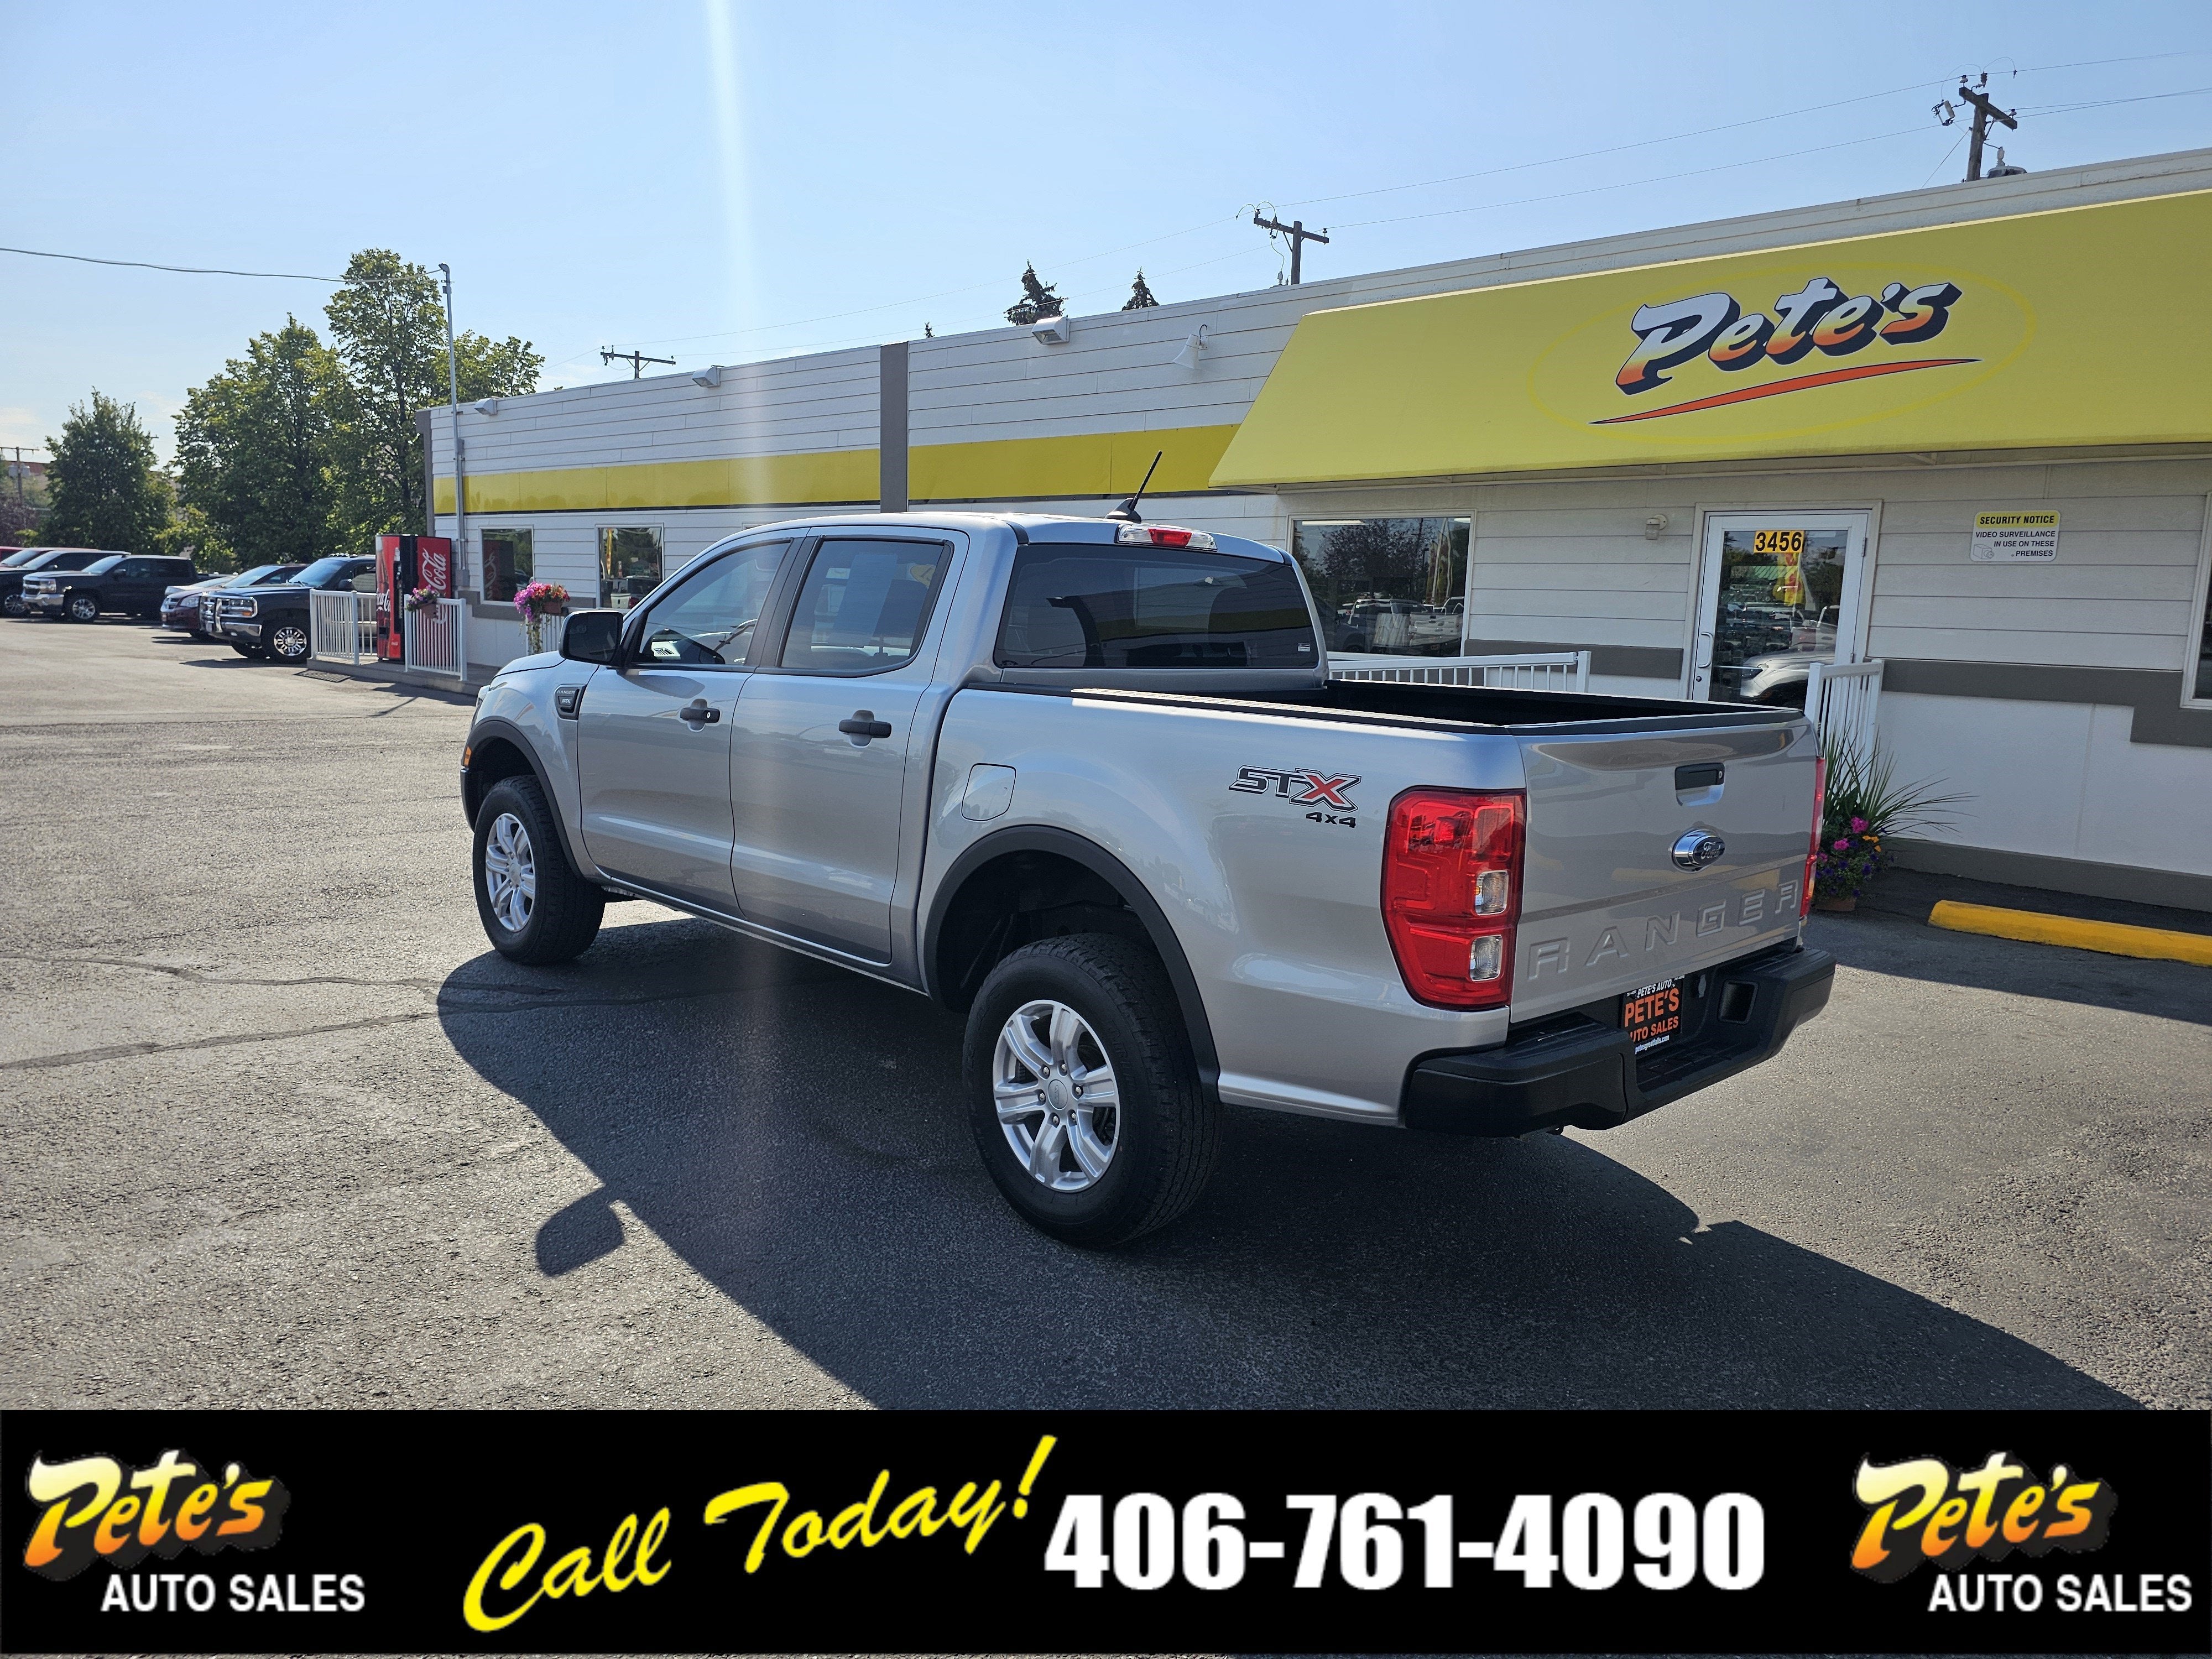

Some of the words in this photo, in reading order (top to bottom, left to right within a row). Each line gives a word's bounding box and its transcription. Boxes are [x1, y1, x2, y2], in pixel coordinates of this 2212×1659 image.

[1615, 277, 1963, 395] Pete's
[1980, 516, 2021, 525] SECURITY
[2023, 515, 2054, 524] NOTICE
[1755, 531, 1802, 551] 3456
[1228, 765, 1362, 813] STX
[1700, 841, 1721, 860] Ford
[1527, 879, 1798, 980] RANGER
[1637, 983, 1656, 998] PETE'S
[1656, 978, 1672, 992] AUTO
[1624, 988, 1679, 1027] PETE'S
[1630, 1026, 1648, 1042] UTO
[1651, 1015, 1679, 1036] SALES
